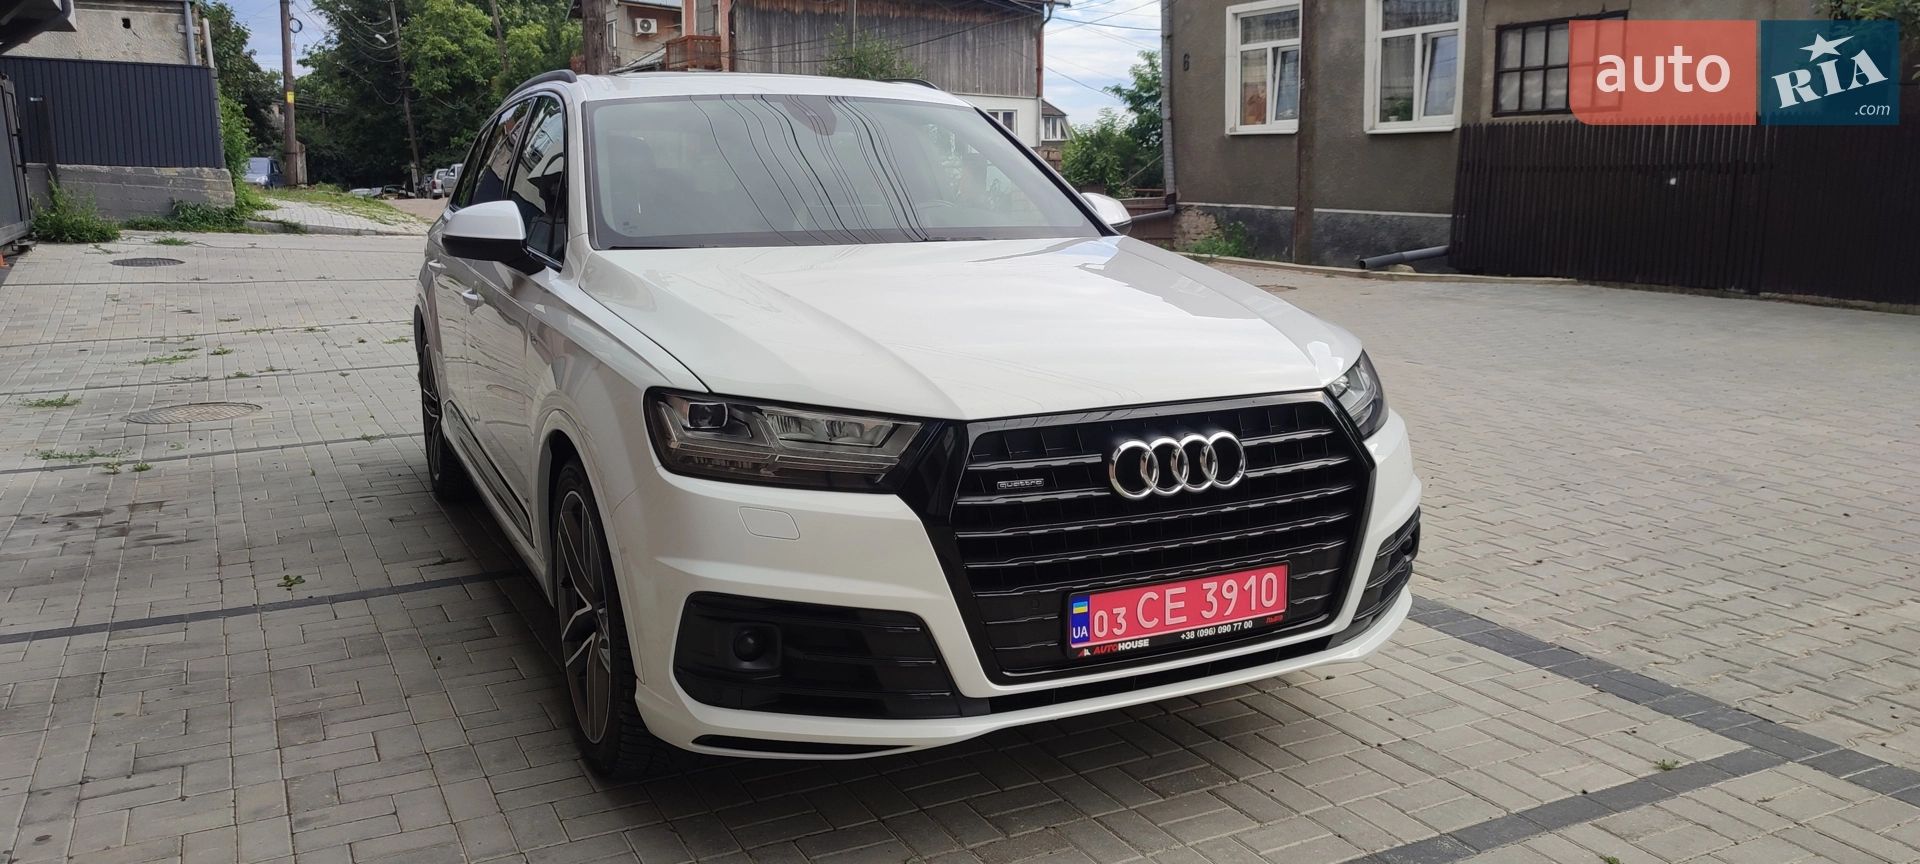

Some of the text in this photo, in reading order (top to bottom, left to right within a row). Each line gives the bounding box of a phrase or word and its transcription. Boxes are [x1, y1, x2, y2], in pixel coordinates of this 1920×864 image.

[1093, 572, 1278, 638] 03 CE 3910
[1072, 625, 1089, 639] UA
[1180, 620, 1253, 640] +38 (096) 090 77 00
